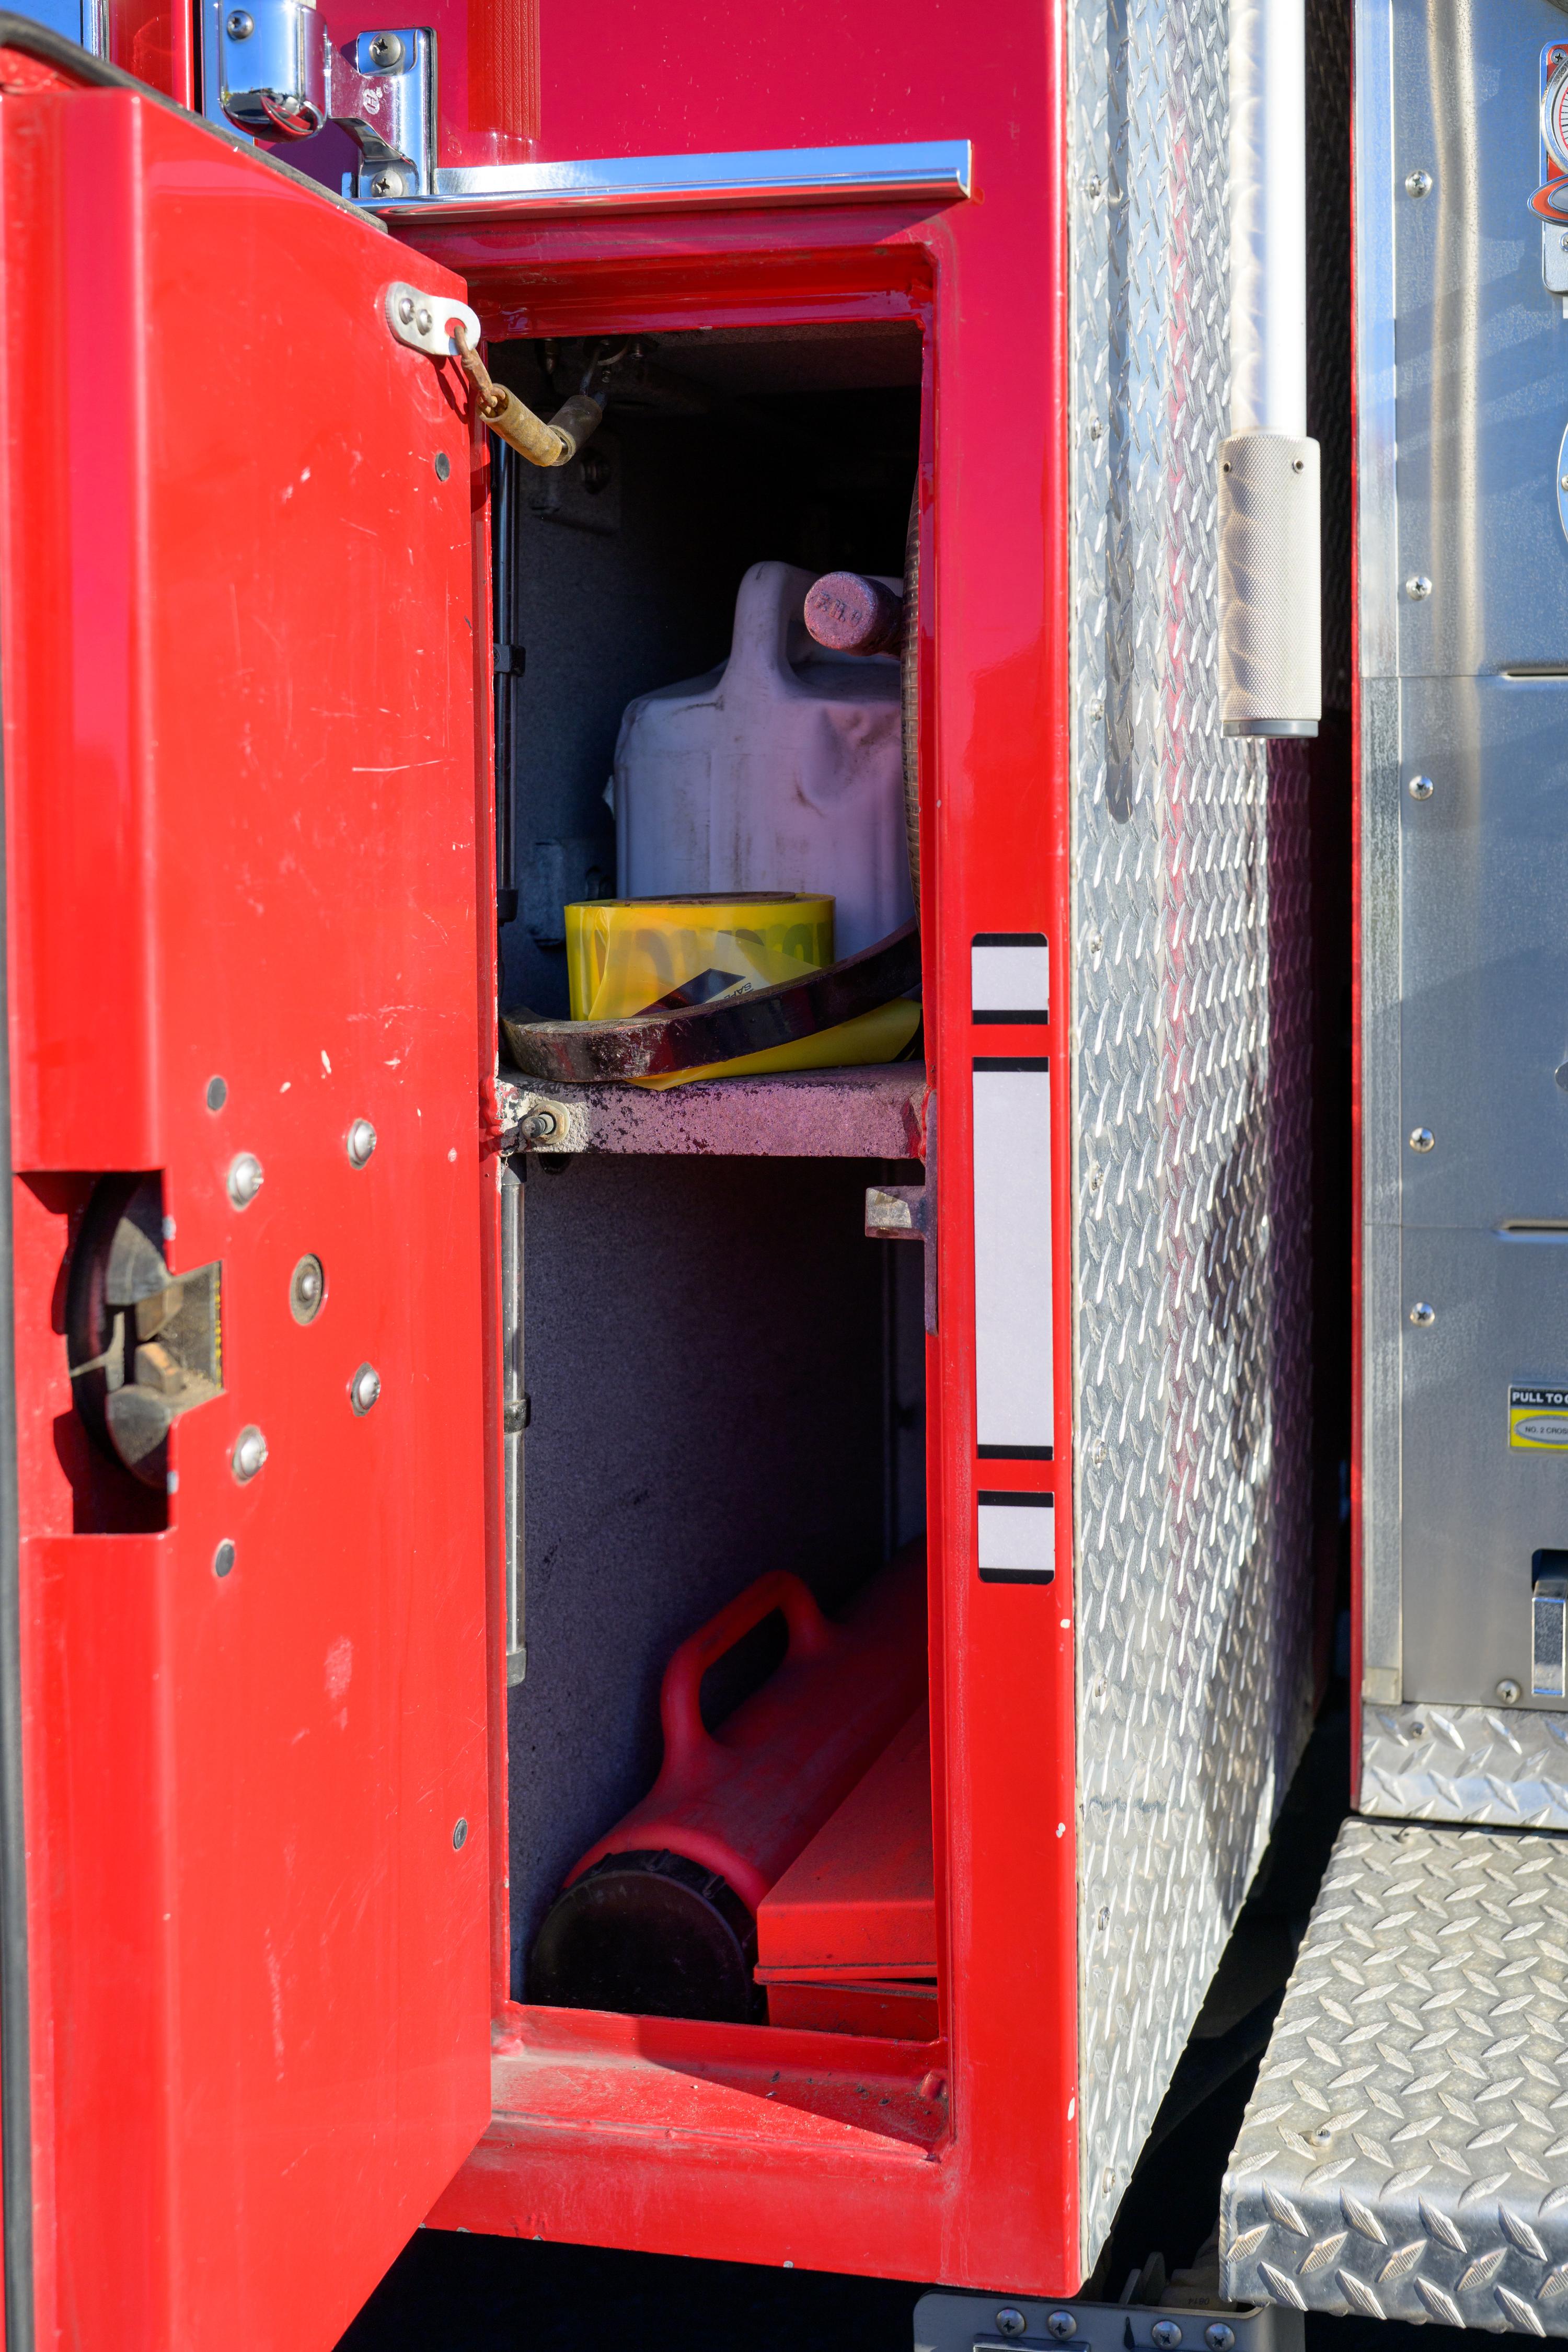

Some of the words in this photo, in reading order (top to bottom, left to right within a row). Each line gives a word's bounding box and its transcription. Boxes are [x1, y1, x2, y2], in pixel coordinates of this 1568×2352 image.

[724, 983, 751, 998] SAF
[1512, 1391, 1544, 1403] PULL
[1546, 1393, 1563, 1404] TO
